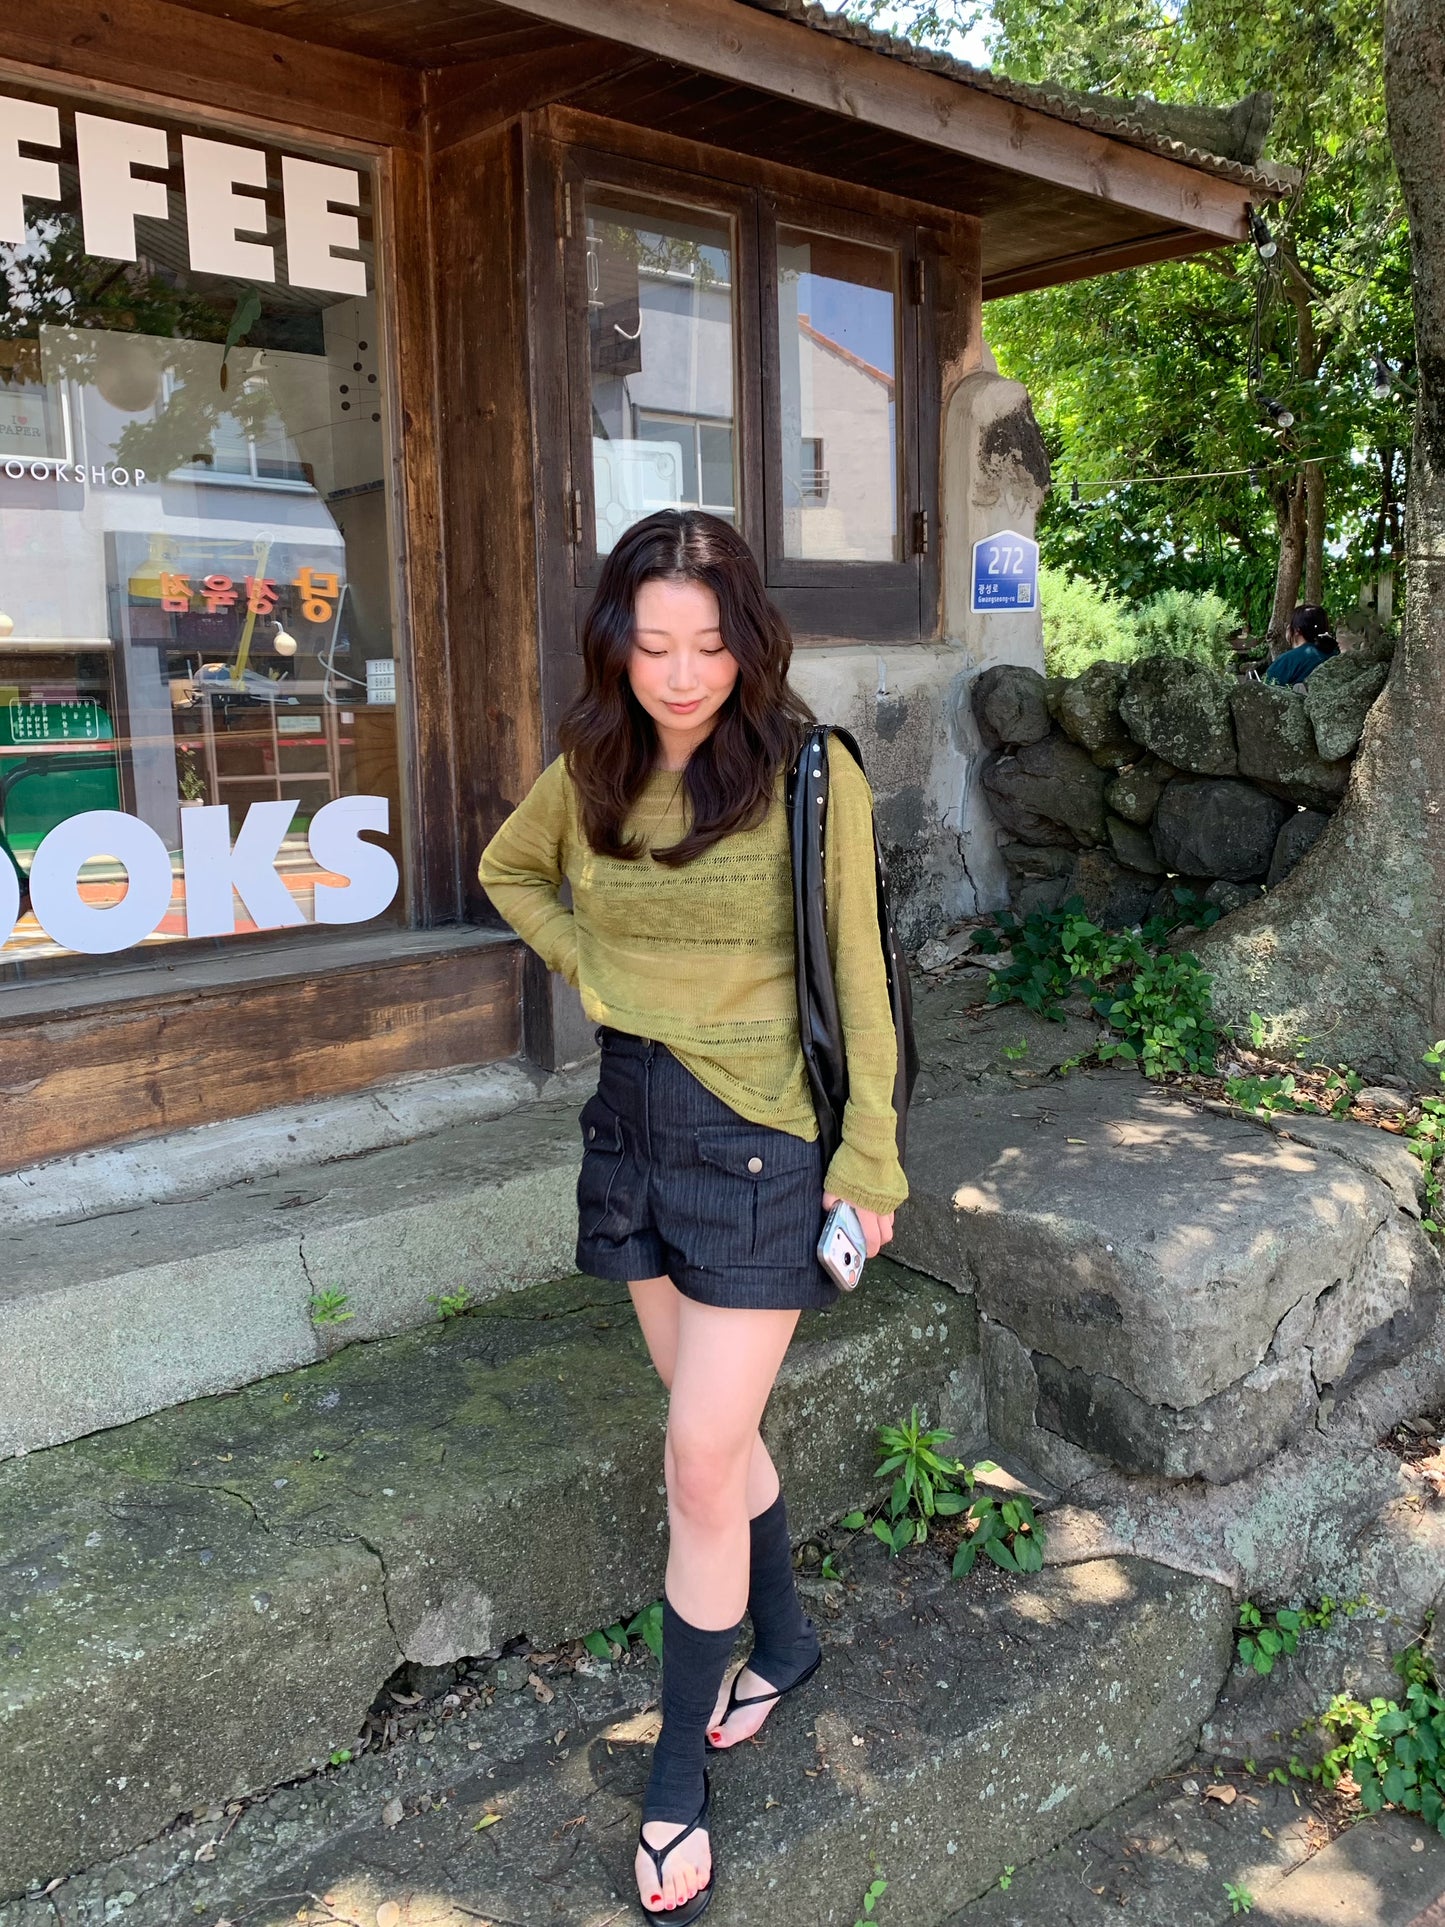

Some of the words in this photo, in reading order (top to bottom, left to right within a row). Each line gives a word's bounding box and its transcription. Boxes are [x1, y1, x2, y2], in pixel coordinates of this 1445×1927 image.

[5, 460, 146, 487] OOKSHOP
[988, 546, 1024, 575] 272
[0, 795, 399, 954] OKS
